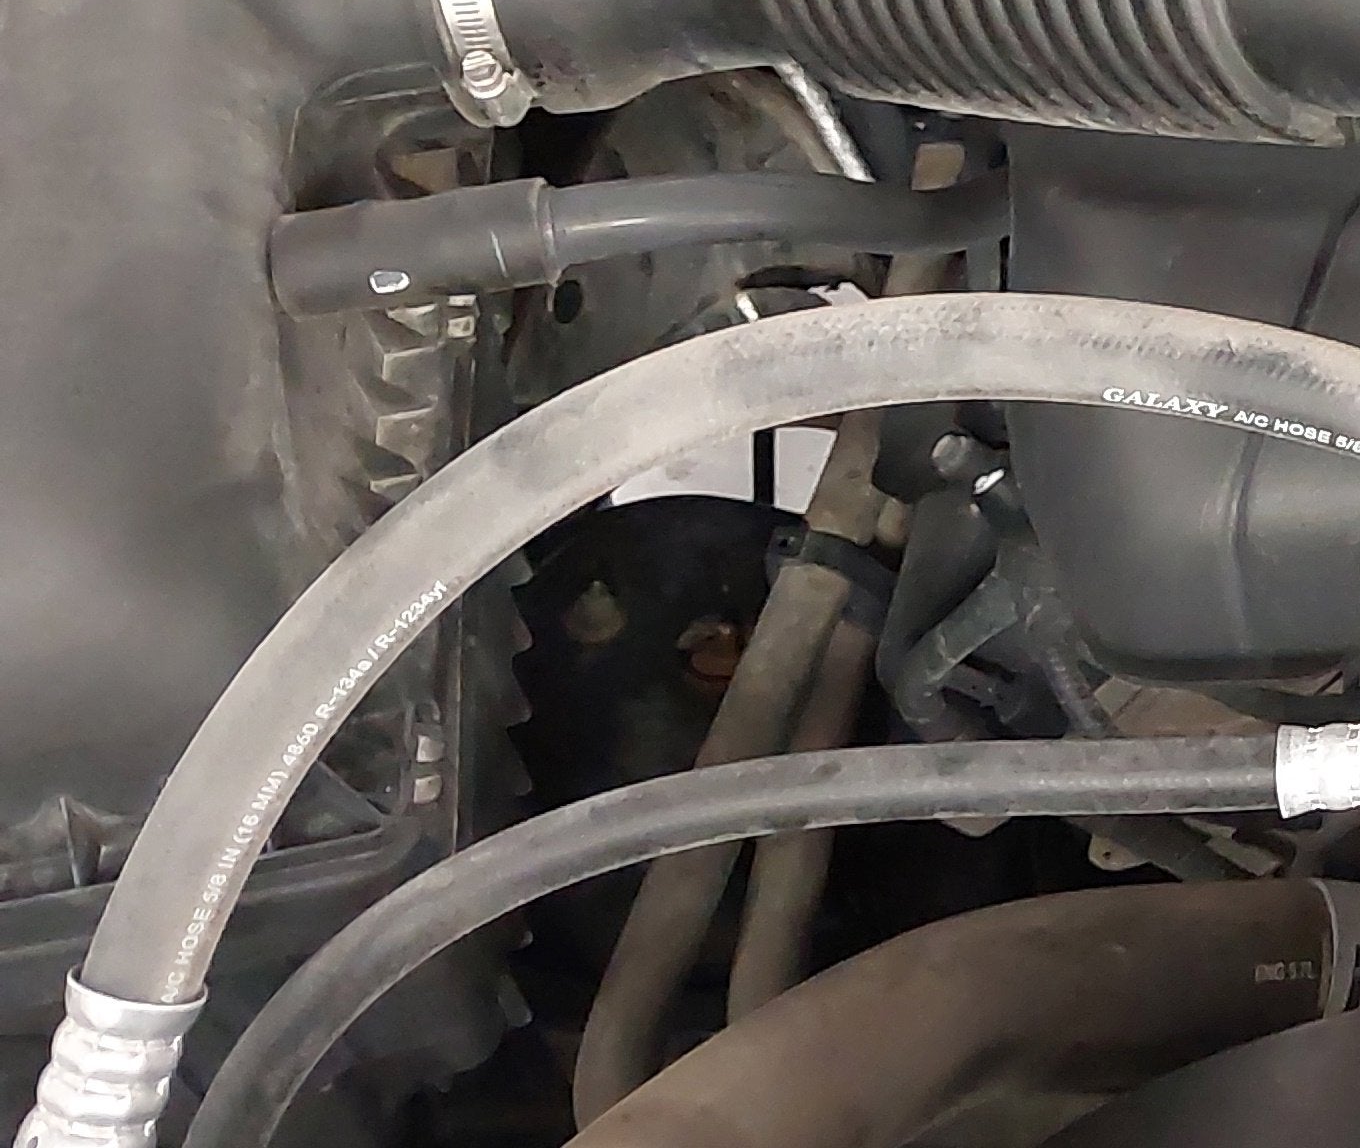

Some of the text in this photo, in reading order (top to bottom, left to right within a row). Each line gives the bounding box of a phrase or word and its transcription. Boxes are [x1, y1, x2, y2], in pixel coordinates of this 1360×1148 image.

[1102, 387, 1229, 419] GALAXY
[1233, 410, 1270, 429] A/C
[1273, 417, 1333, 445] HOSE
[174, 907, 212, 966] HOSE
[217, 847, 242, 870] IN
[232, 813, 260, 844] (16
[250, 770, 289, 812] MM)
[281, 722, 320, 767] 4860
[314, 659, 374, 720] R-134a
